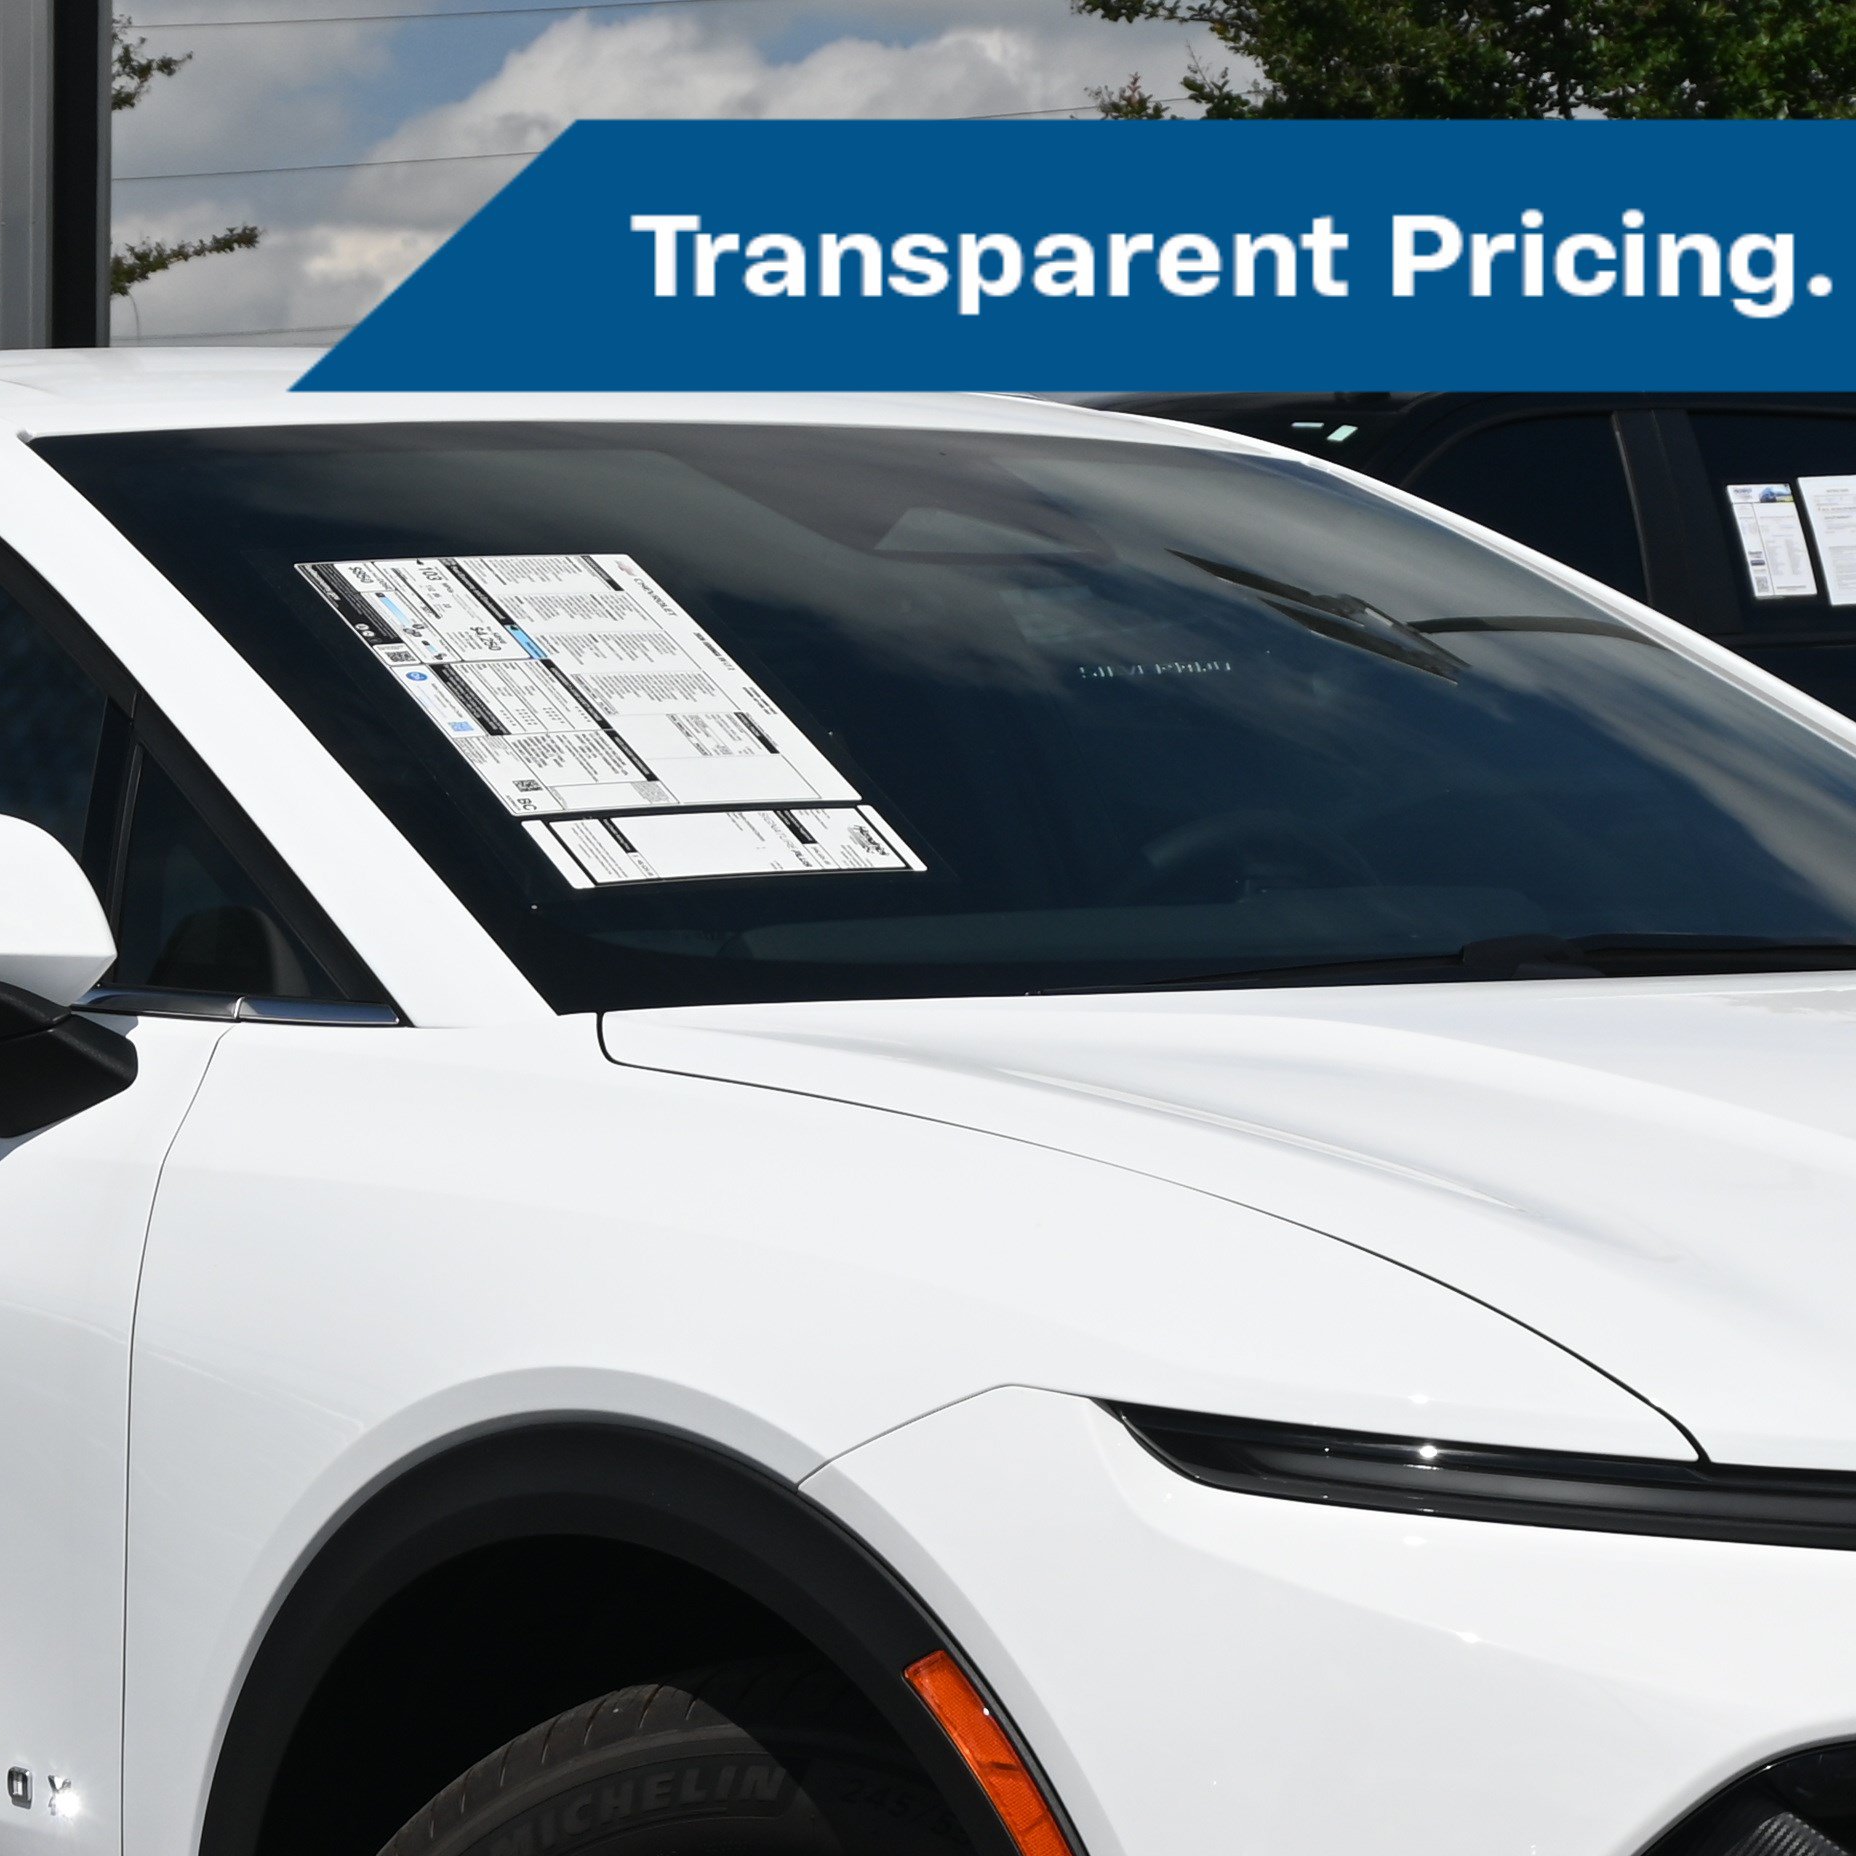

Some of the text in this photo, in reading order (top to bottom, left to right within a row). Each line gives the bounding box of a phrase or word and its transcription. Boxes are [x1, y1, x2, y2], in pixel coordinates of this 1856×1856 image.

[419, 561, 442, 582] 103
[634, 577, 678, 617] CHEVROLET
[470, 626, 502, 652] $4,250
